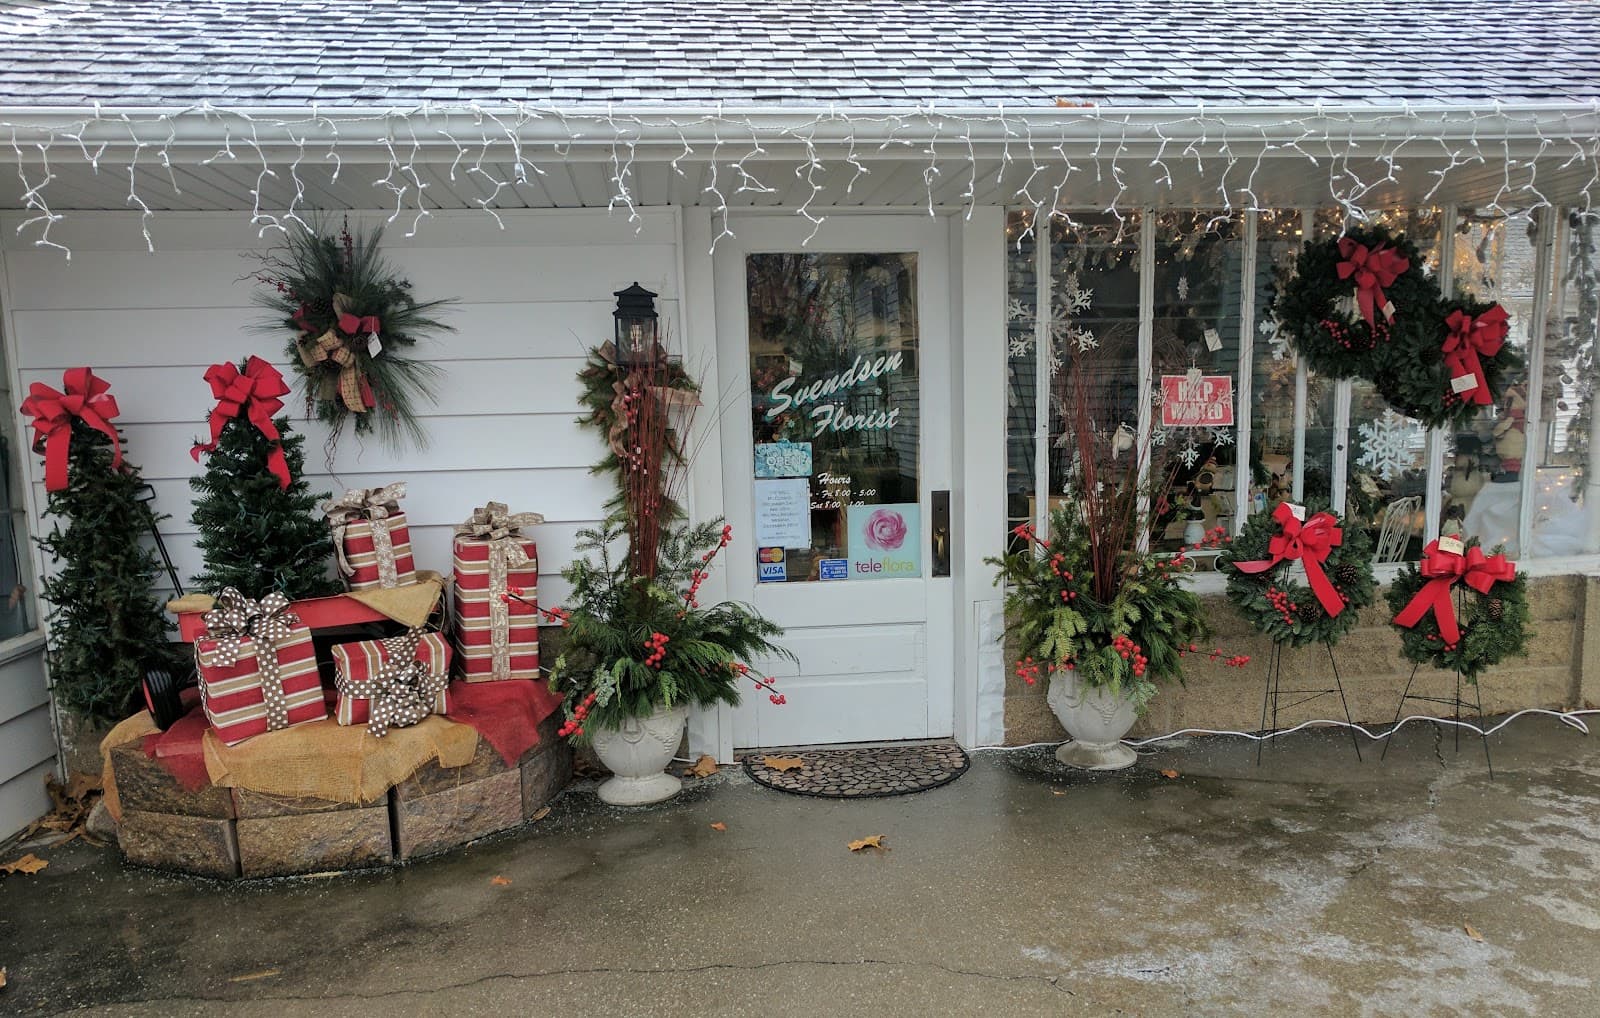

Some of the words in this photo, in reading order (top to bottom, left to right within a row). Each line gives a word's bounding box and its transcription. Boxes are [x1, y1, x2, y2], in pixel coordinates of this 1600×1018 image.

[766, 351, 903, 419] Svendsen
[811, 404, 900, 438] Florist
[817, 472, 851, 484] Hours
[821, 489, 833, 498] Fri
[834, 489, 851, 497] 8:00
[810, 501, 823, 510] Sat
[824, 500, 840, 509] 8:00
[763, 566, 784, 575] VISA
[855, 557, 914, 573] teleflora
